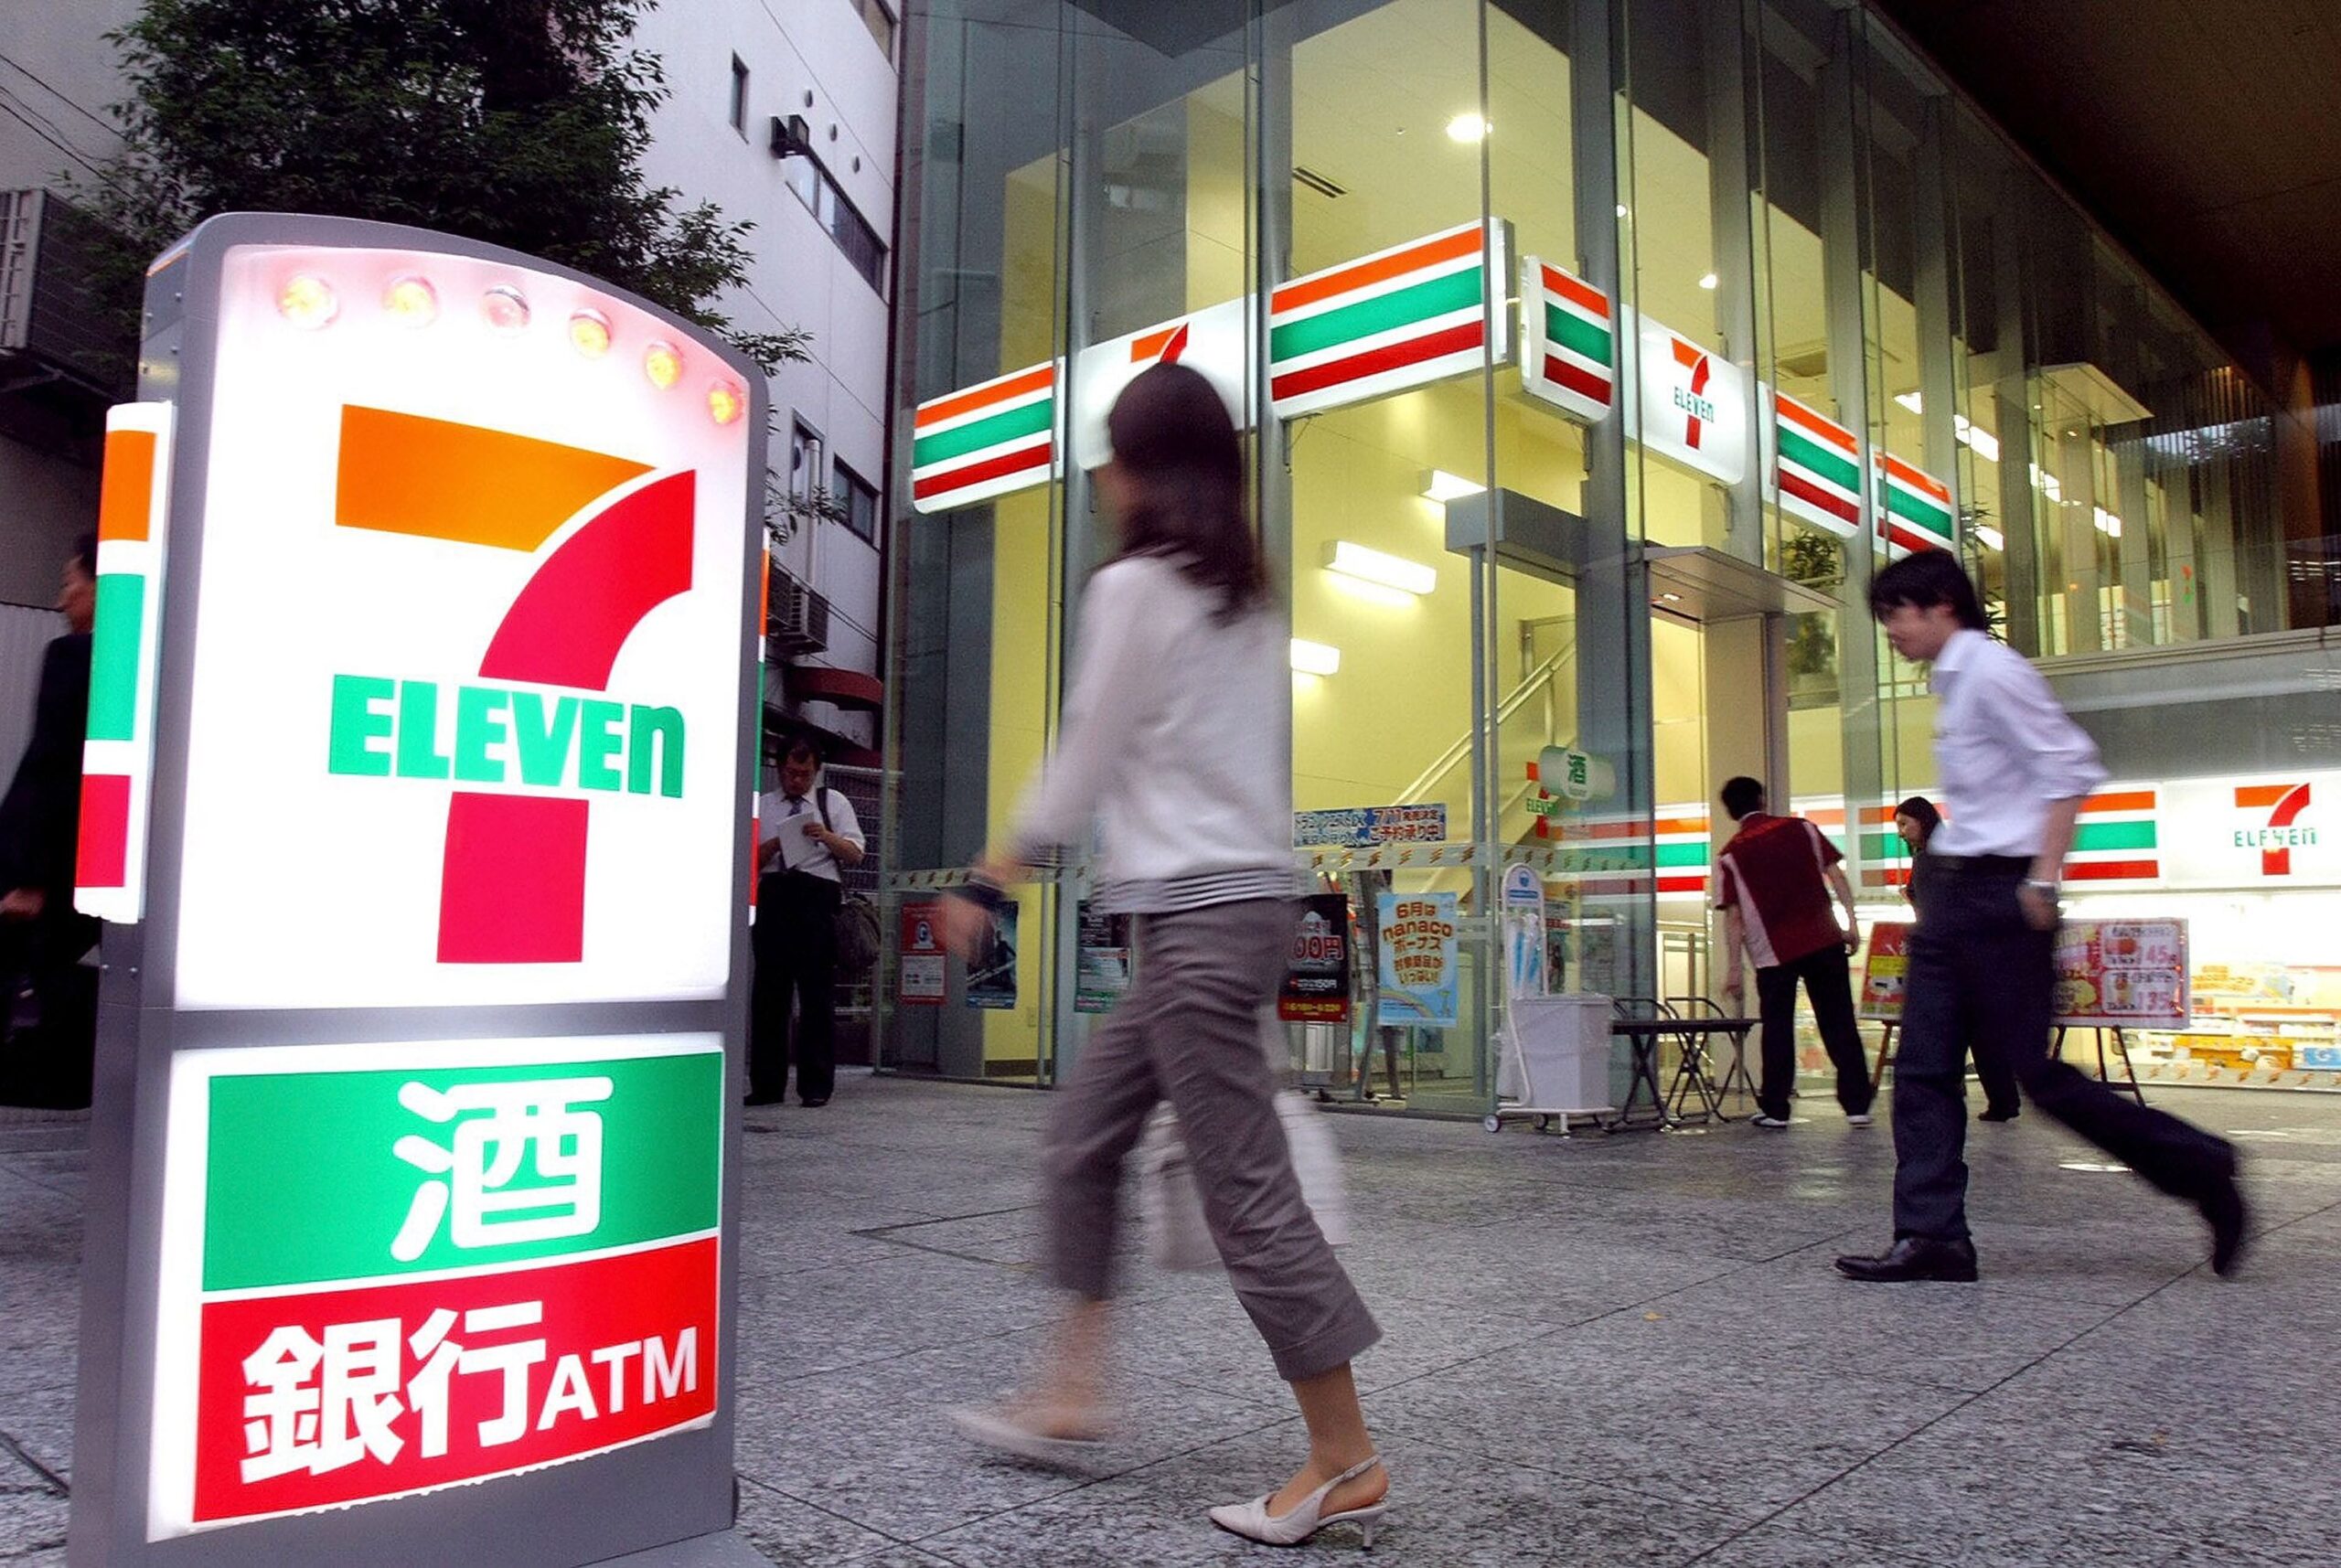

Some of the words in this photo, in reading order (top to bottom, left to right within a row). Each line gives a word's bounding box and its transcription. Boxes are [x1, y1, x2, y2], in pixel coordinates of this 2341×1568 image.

[1671, 337, 1710, 451] 7
[336, 403, 696, 963] 7
[1567, 753, 1587, 784] 酒
[2234, 783, 2311, 876] 7
[1383, 921, 1452, 941] nanaco
[1395, 901, 1436, 919] 6月は
[390, 1076, 614, 1263] 酒
